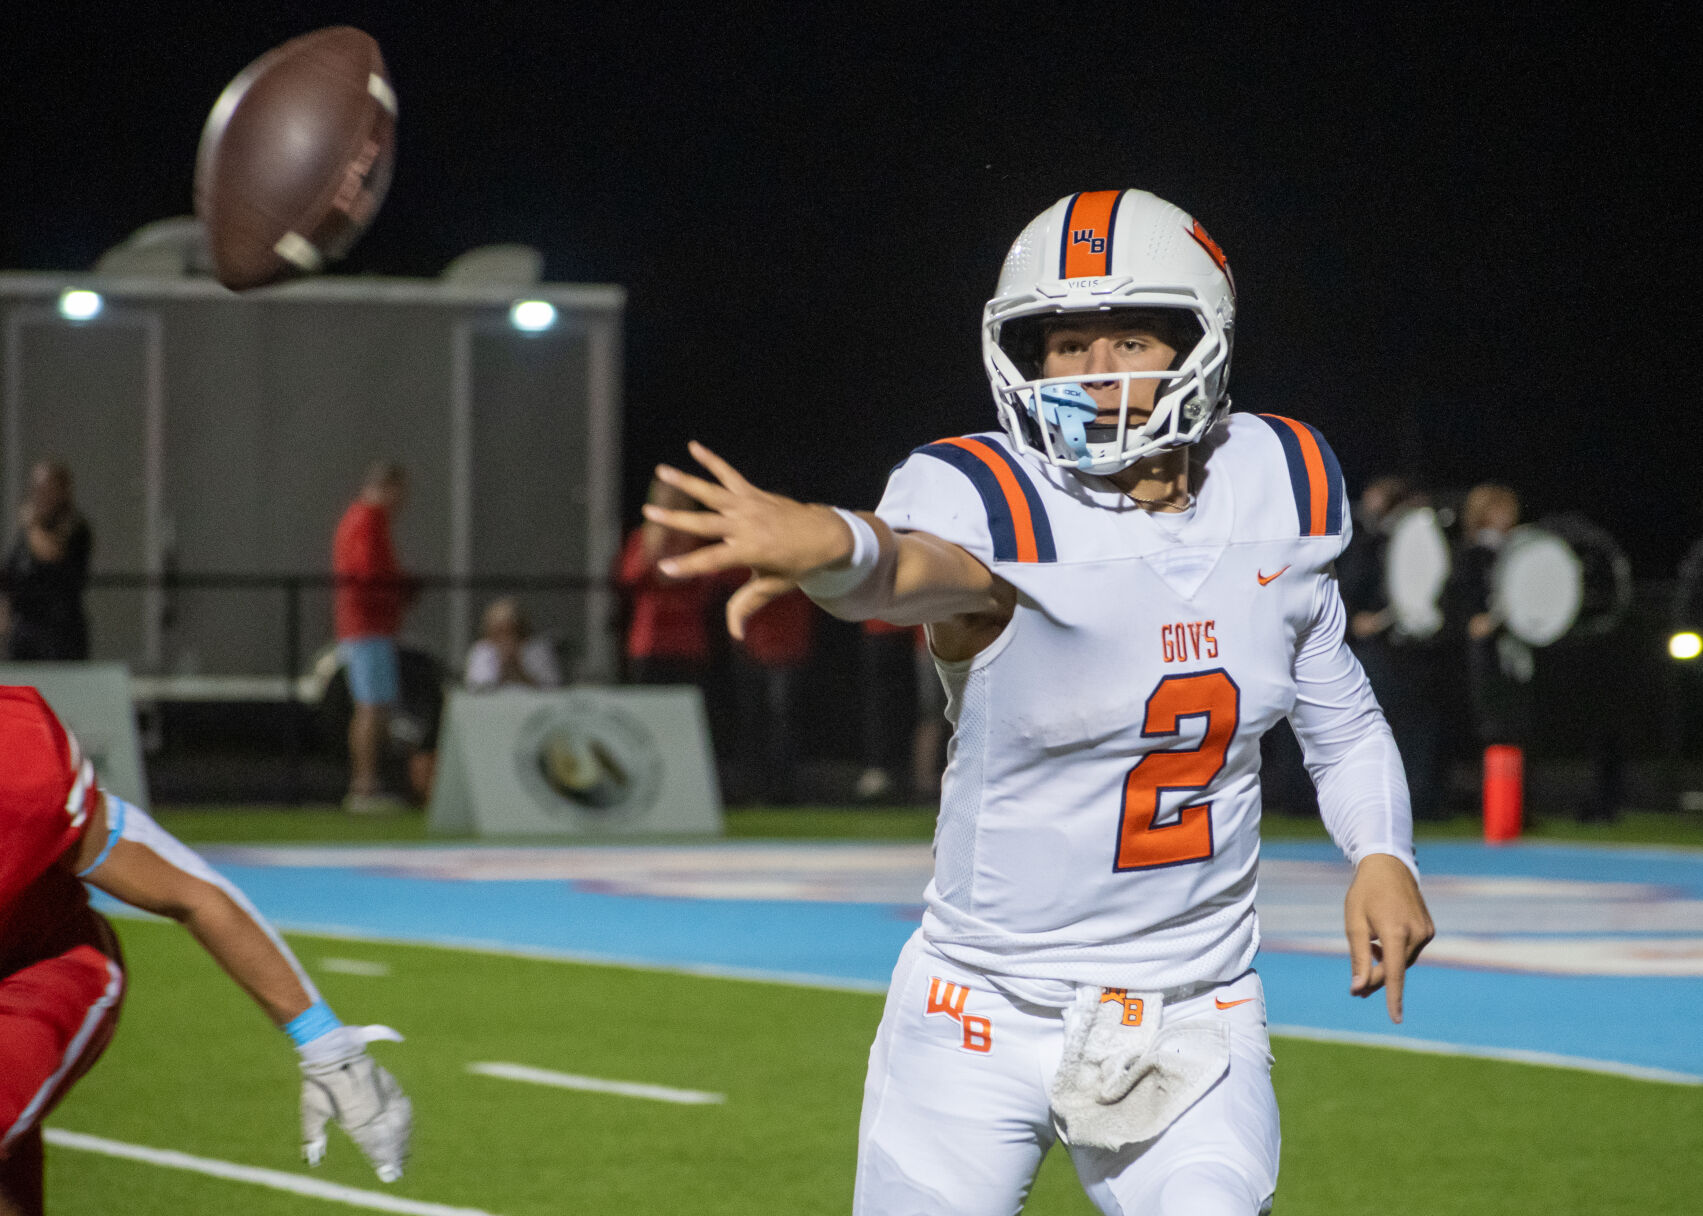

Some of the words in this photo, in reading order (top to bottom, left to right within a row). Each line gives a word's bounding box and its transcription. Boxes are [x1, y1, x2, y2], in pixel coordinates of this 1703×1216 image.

[1068, 279, 1099, 289] VICIS
[1161, 620, 1218, 663] GOVS
[1112, 667, 1240, 873] 2
